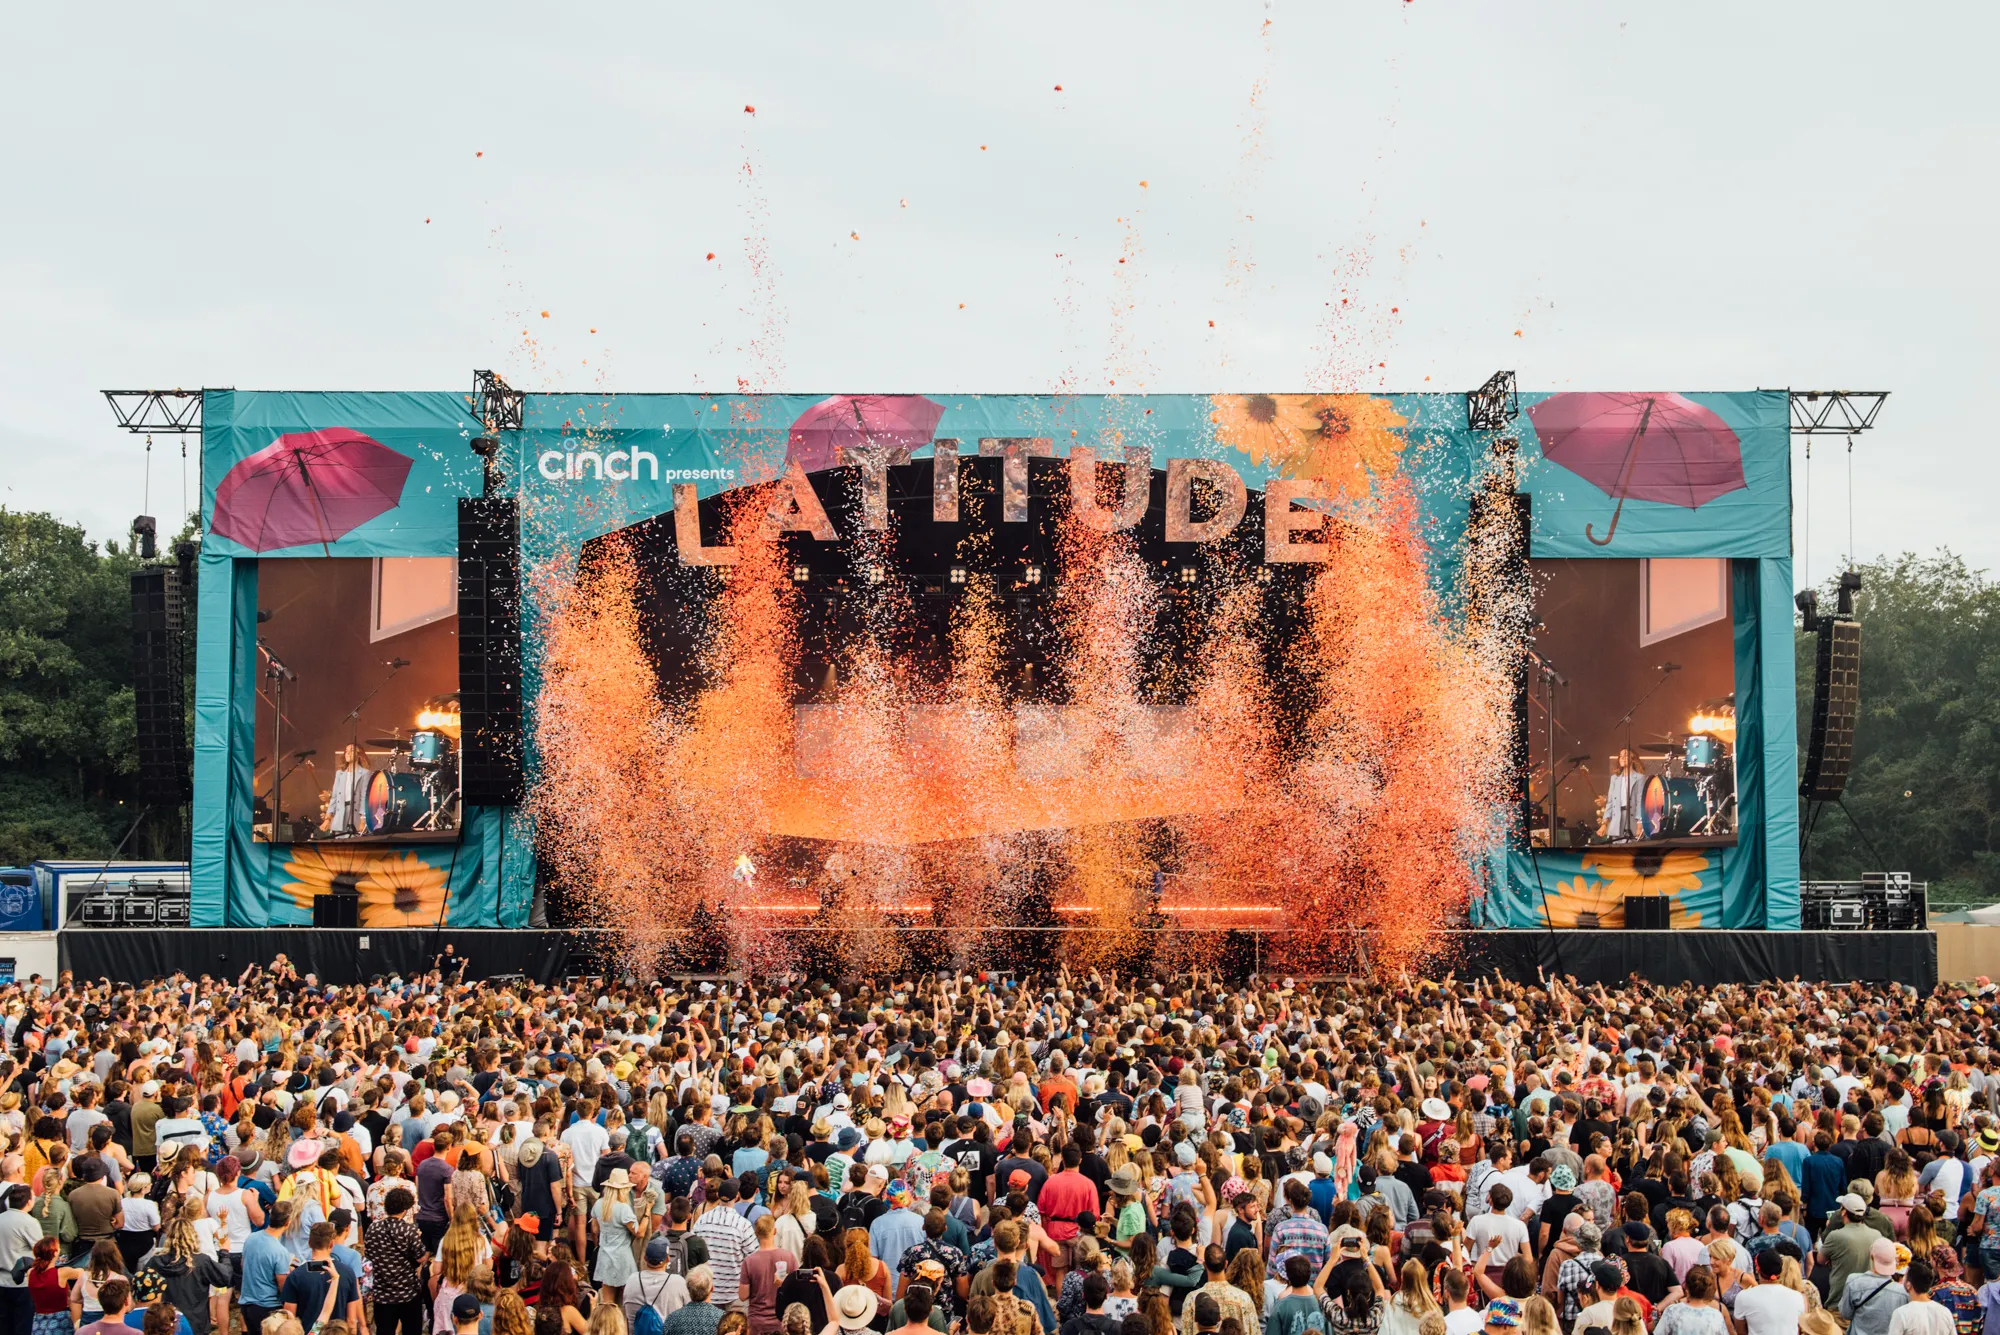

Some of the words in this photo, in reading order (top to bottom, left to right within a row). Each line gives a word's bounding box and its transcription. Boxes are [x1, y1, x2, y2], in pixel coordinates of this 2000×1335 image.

[538, 438, 658, 481] cinch
[666, 466, 735, 484] presents
[671, 437, 1331, 567] LATITUDE
